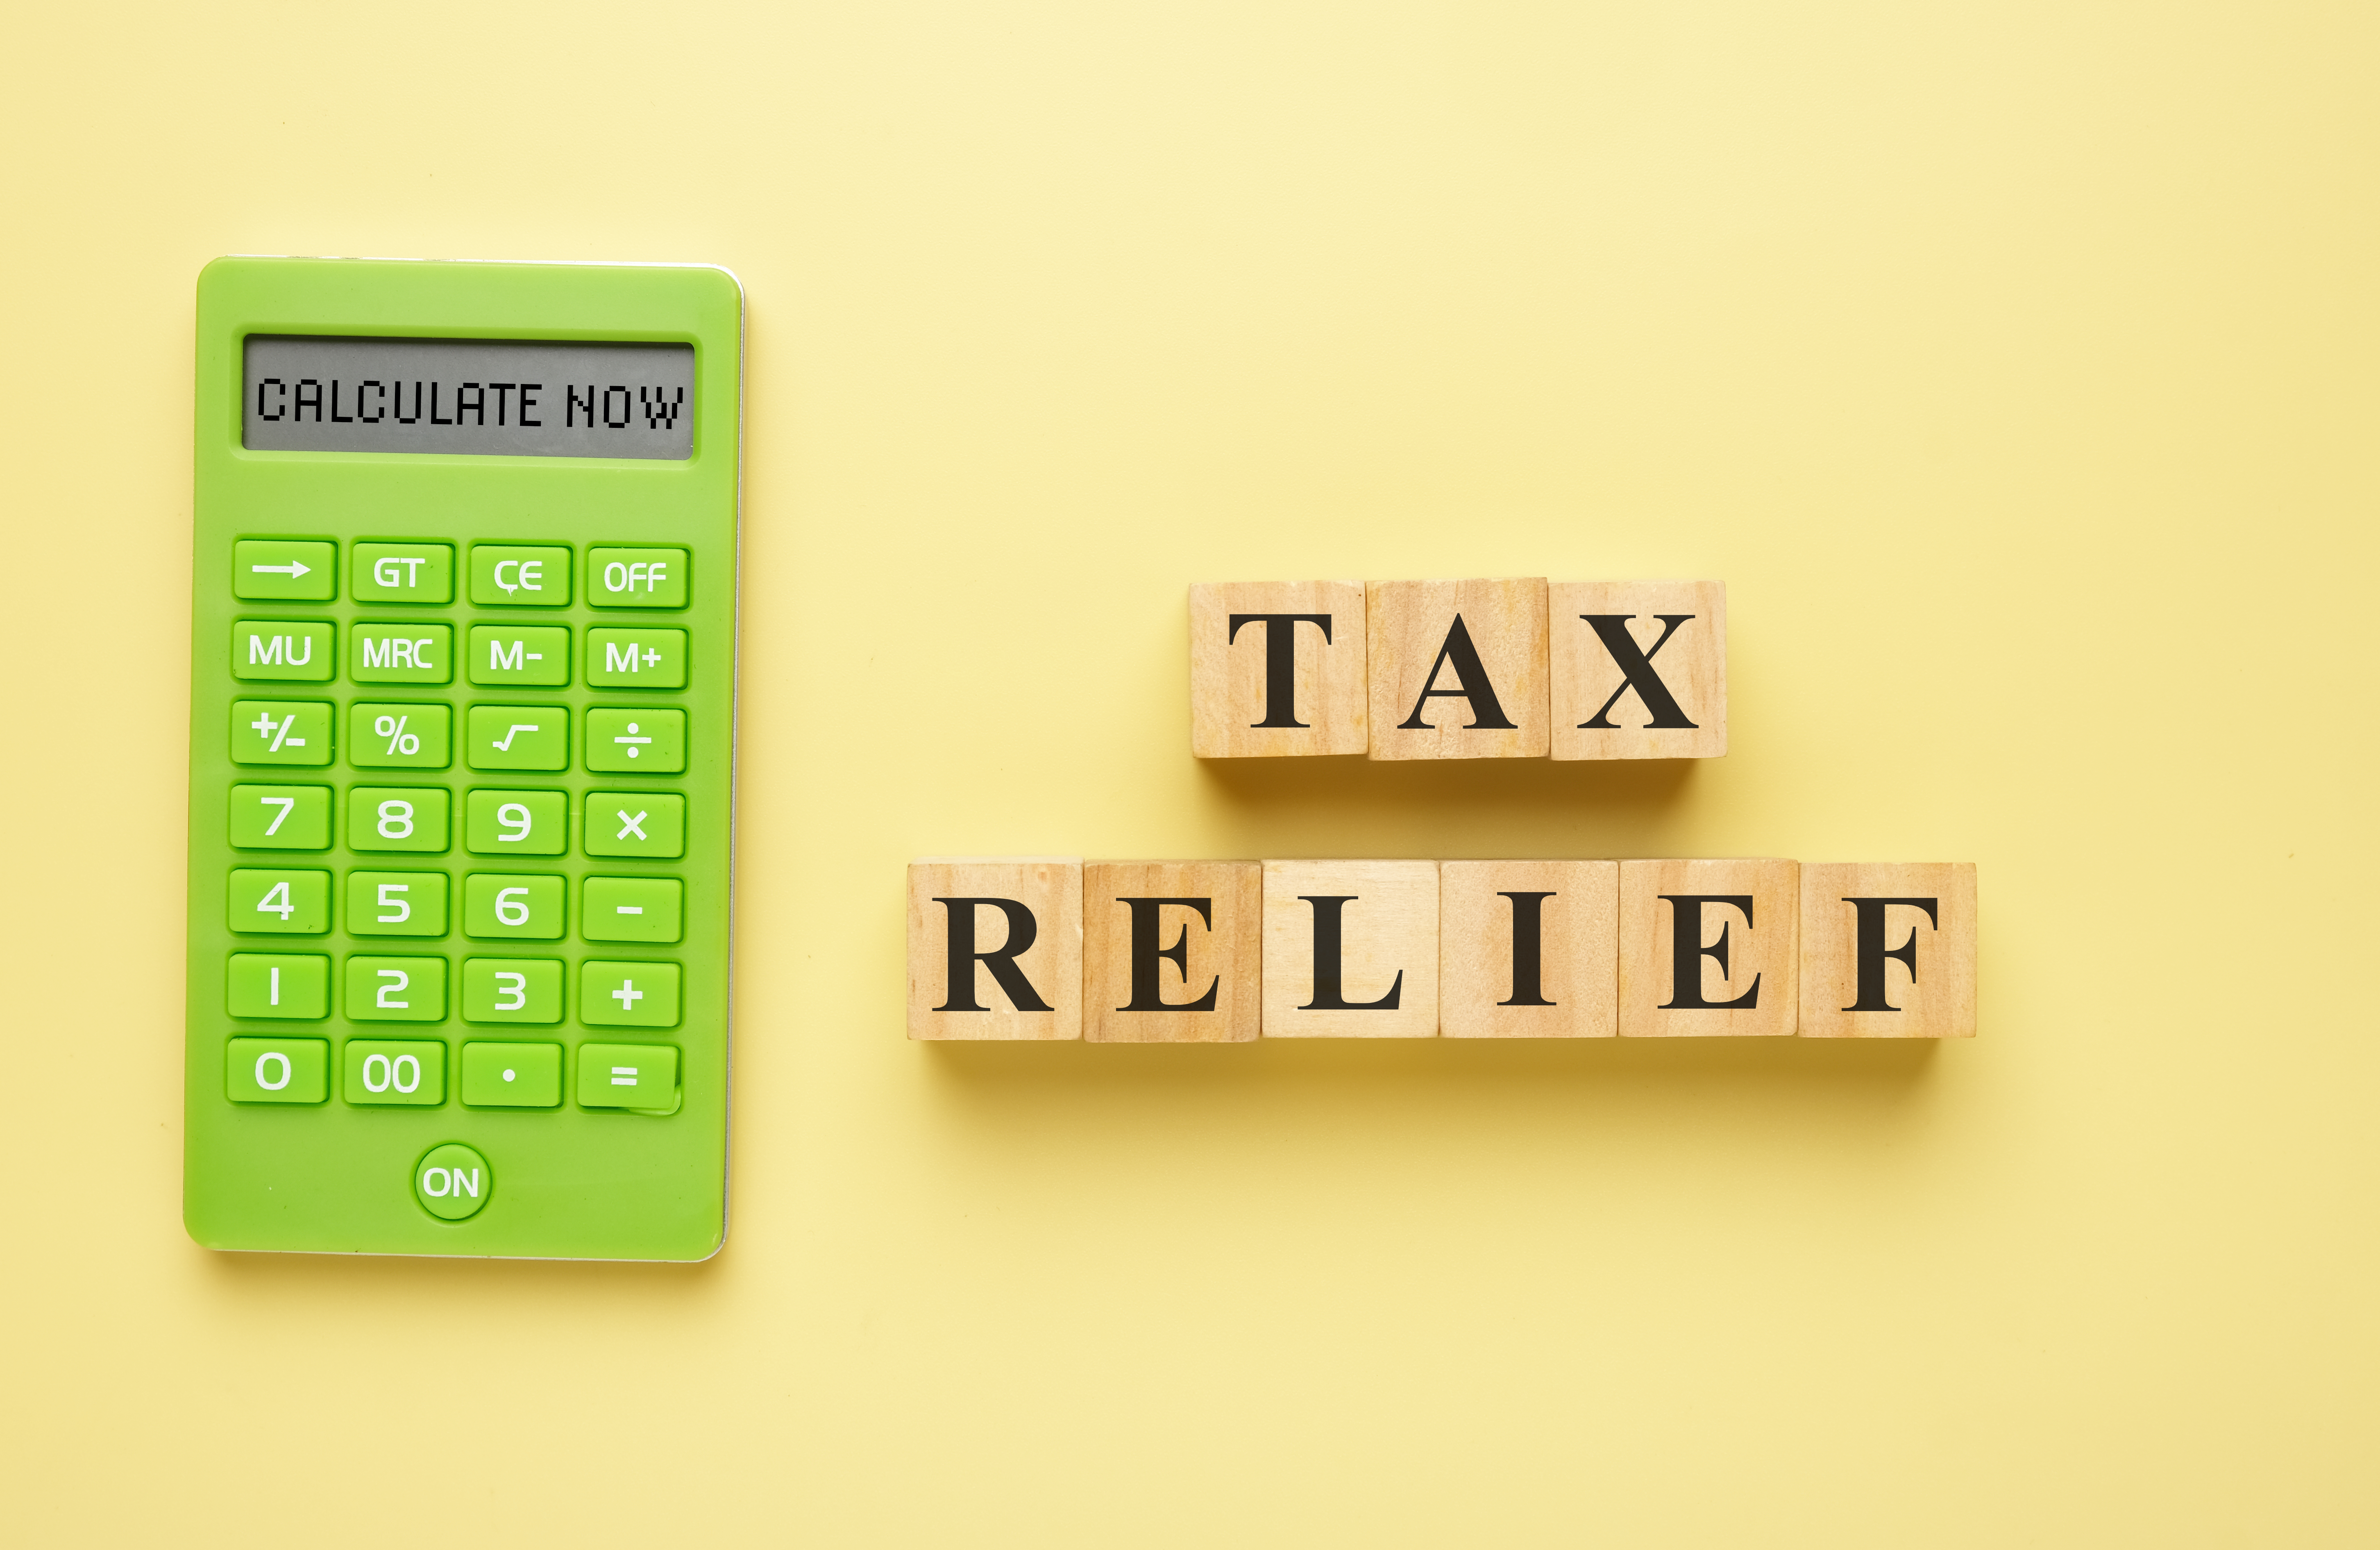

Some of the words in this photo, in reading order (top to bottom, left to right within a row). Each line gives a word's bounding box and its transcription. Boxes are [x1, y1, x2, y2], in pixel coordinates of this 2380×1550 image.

[259, 379, 542, 426] CALCULATE
[567, 385, 683, 429] NOW
[374, 558, 425, 587] GT
[604, 562, 666, 592] OFF
[250, 635, 311, 665] MU
[363, 638, 433, 668] MRC
[490, 641, 542, 670] M-
[606, 643, 661, 672] M+
[1230, 613, 1699, 729] TAX
[375, 716, 419, 755] %
[261, 797, 294, 835] 7
[377, 800, 413, 839] 8
[497, 803, 531, 841] 9
[257, 882, 294, 920] 4
[378, 884, 410, 923] 5
[495, 887, 529, 925] 6
[932, 892, 1937, 1011] RELIEF
[377, 970, 408, 1008] 2
[495, 972, 526, 1010] 3
[255, 1052, 291, 1090] 0
[363, 1054, 420, 1093] 00
[423, 1168, 479, 1197] ON
